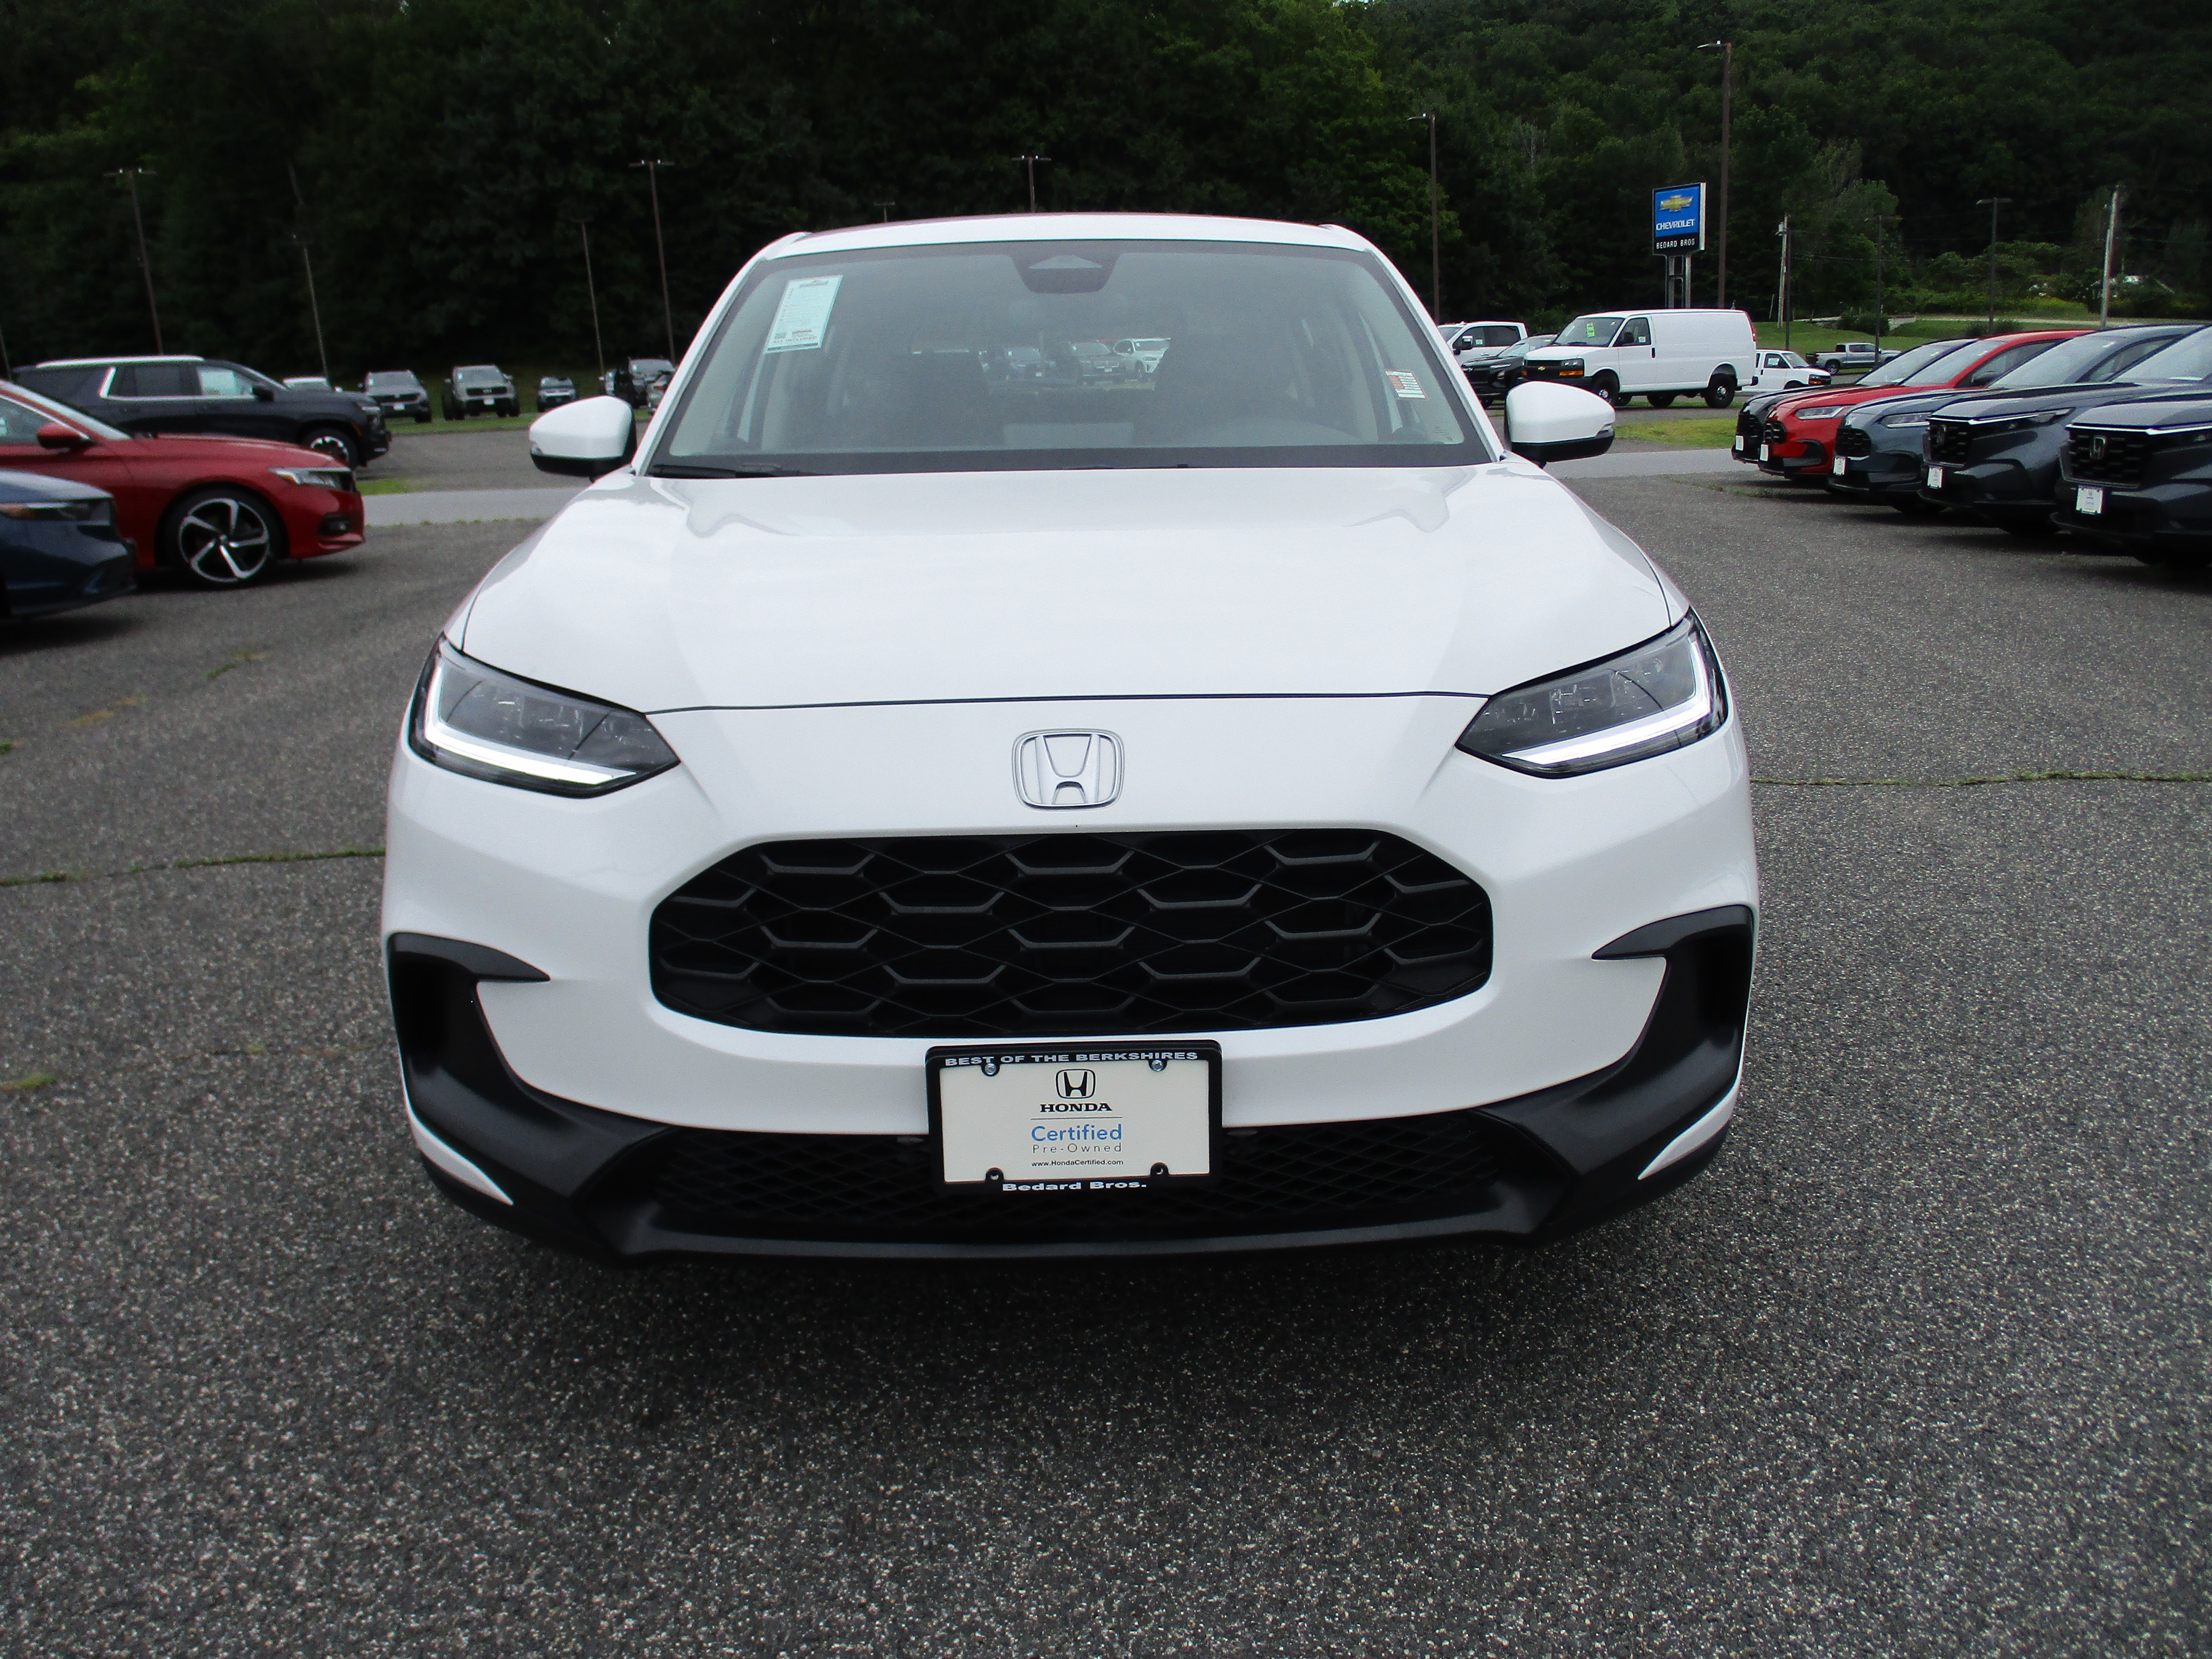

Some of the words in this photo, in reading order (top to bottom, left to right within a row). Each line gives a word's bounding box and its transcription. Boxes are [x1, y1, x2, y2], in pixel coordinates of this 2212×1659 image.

[1656, 219, 1695, 231] CHEVROLET
[1656, 240, 1677, 249] BEDARD
[1680, 238, 1695, 246] BROS
[945, 1056, 994, 1066] BEST
[1076, 1052, 1198, 1061] BERKSHIRES
[1039, 1103, 1113, 1112] HONDA
[1031, 1123, 1122, 1142] Certified
[1033, 1142, 1121, 1154] Pre-Owned
[1002, 1182, 1082, 1191] Bedard
[1089, 1181, 1147, 1189] Bros.
